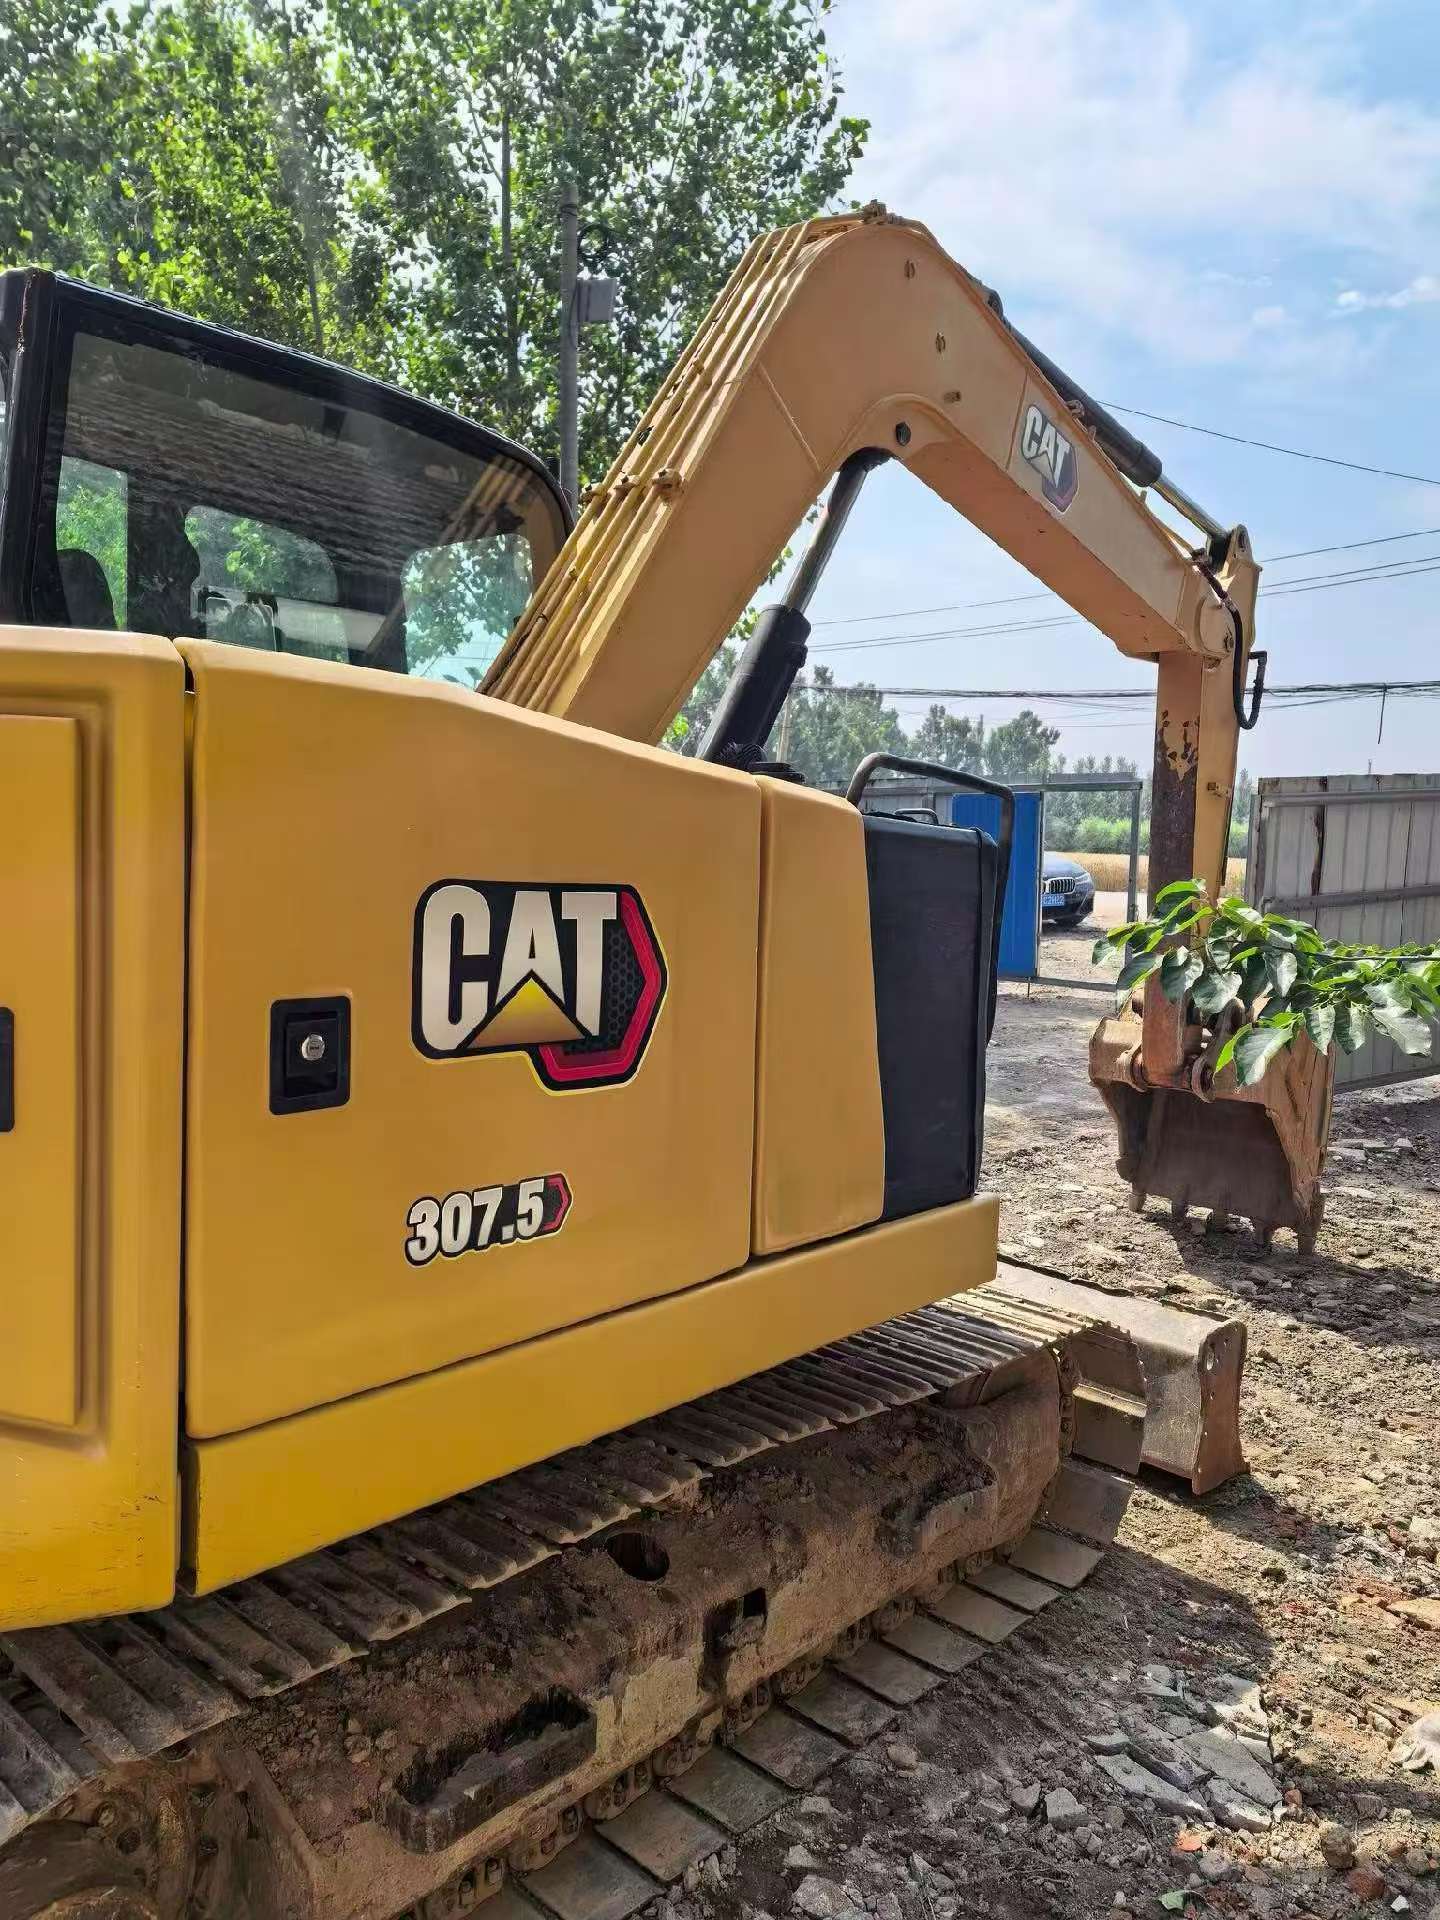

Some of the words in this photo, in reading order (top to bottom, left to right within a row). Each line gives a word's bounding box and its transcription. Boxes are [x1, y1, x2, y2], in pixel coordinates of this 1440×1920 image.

[1023, 406, 1071, 488] CAT
[421, 884, 617, 1051] CAT
[407, 1178, 545, 1262] 307.5
